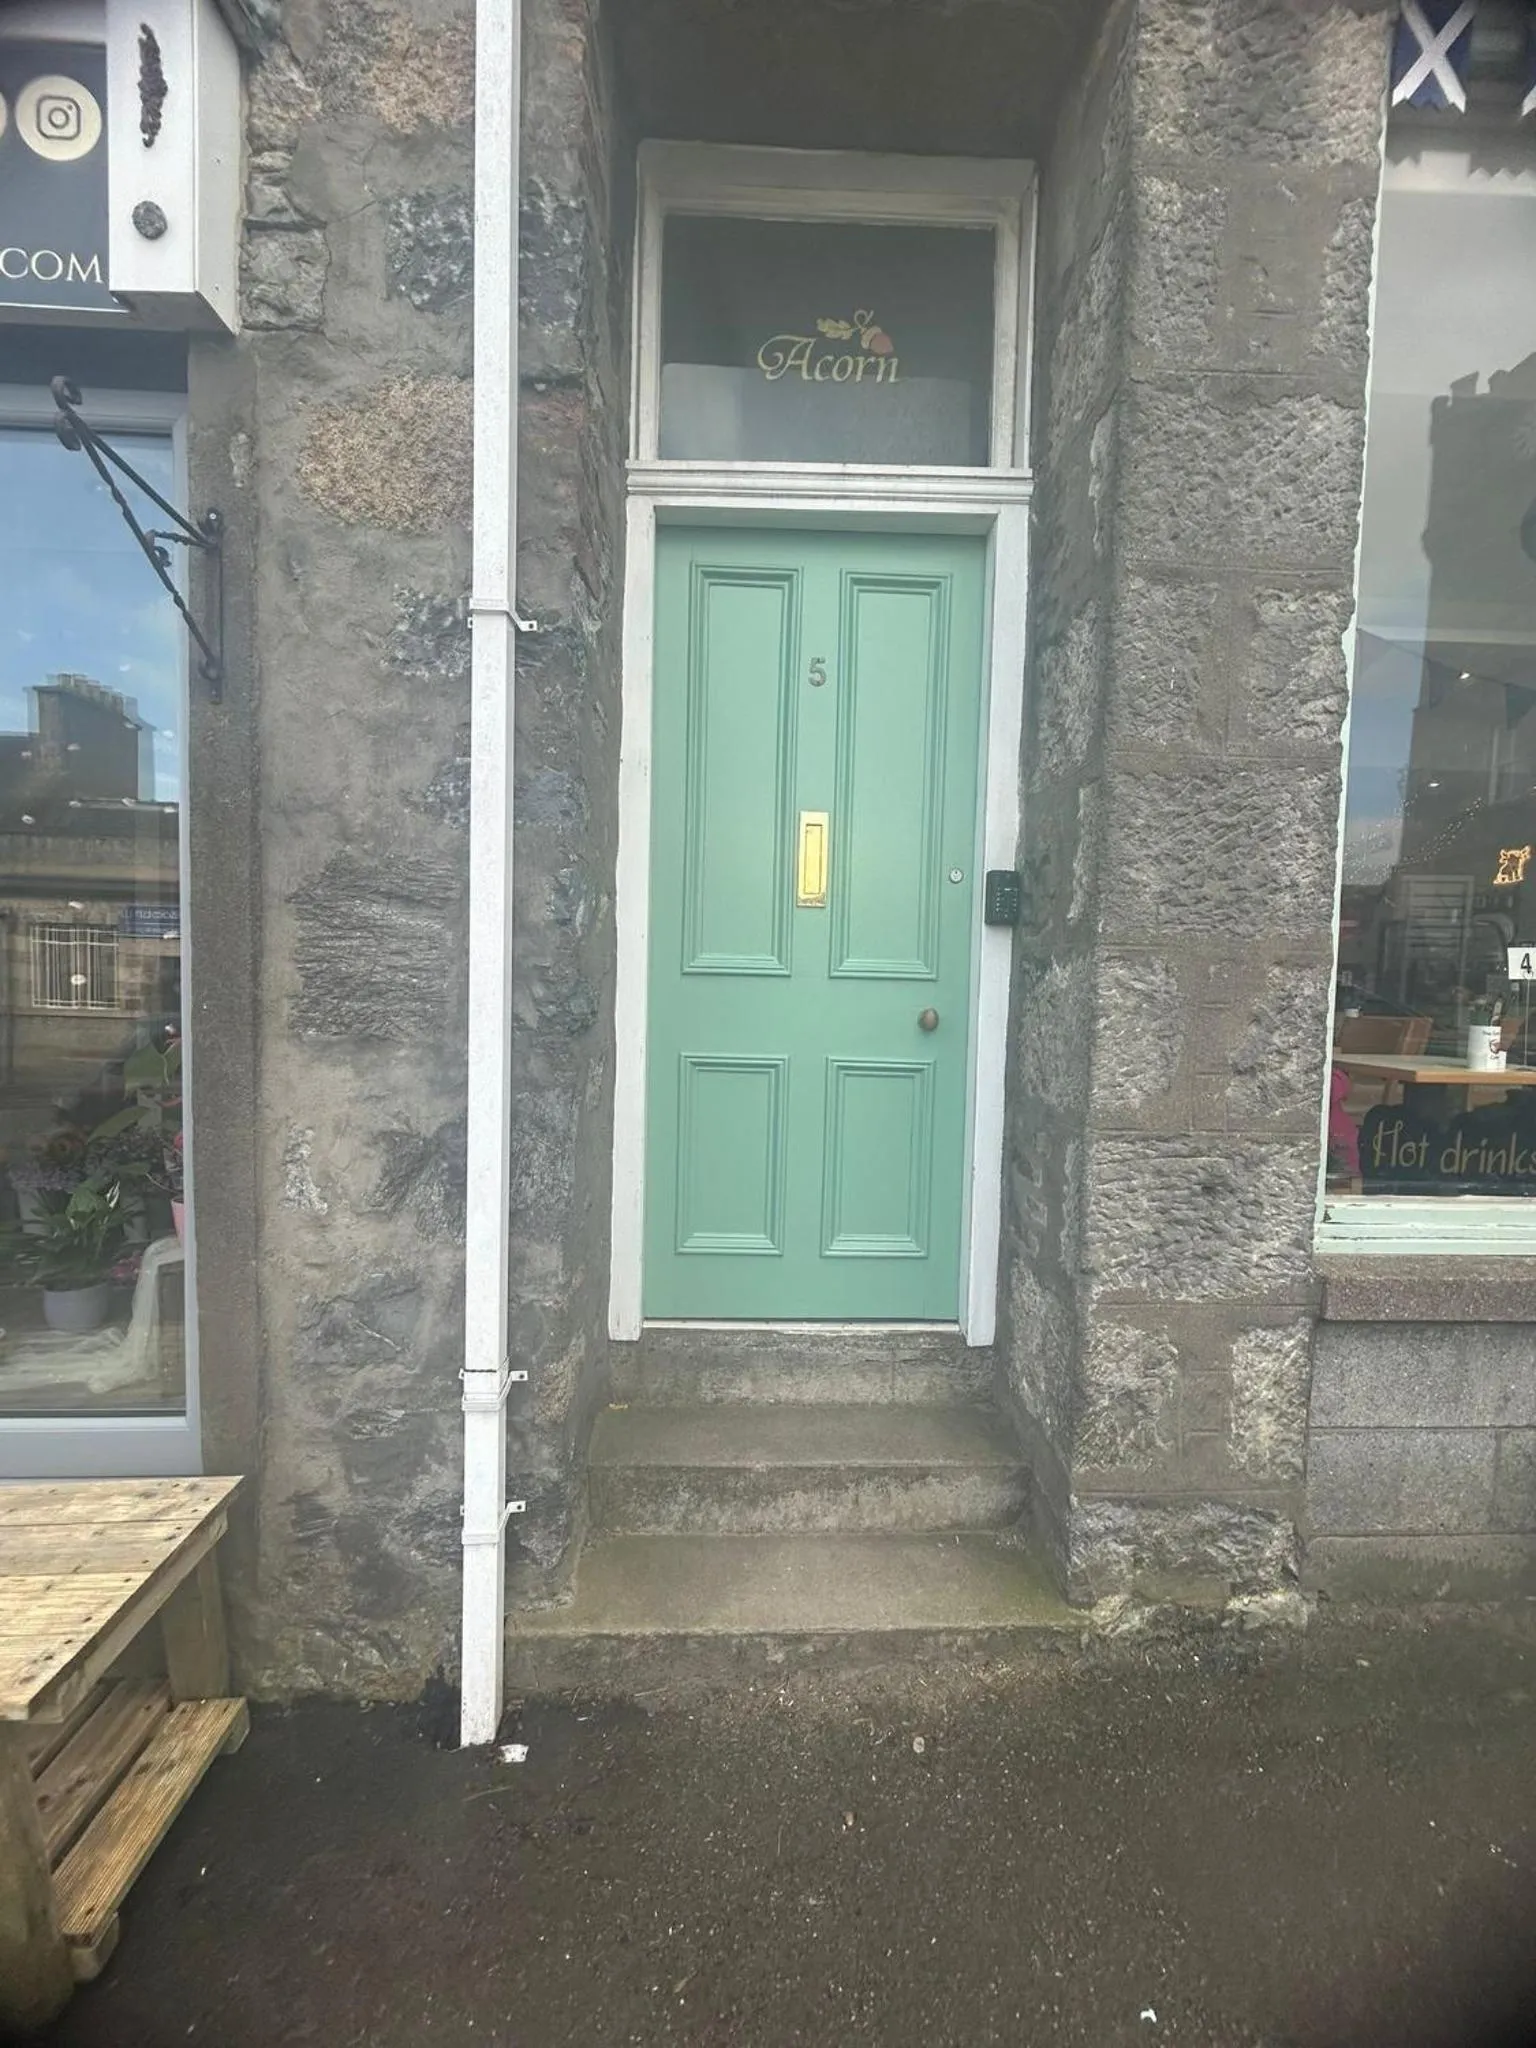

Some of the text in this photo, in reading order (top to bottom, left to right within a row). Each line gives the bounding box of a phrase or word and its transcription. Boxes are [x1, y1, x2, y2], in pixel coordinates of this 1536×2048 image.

[0, 247, 103, 283] COM
[757, 334, 900, 383] Acorn
[808, 656, 827, 687] 5
[1520, 952, 1532, 974] 4
[1373, 1120, 1430, 1168] Hot
